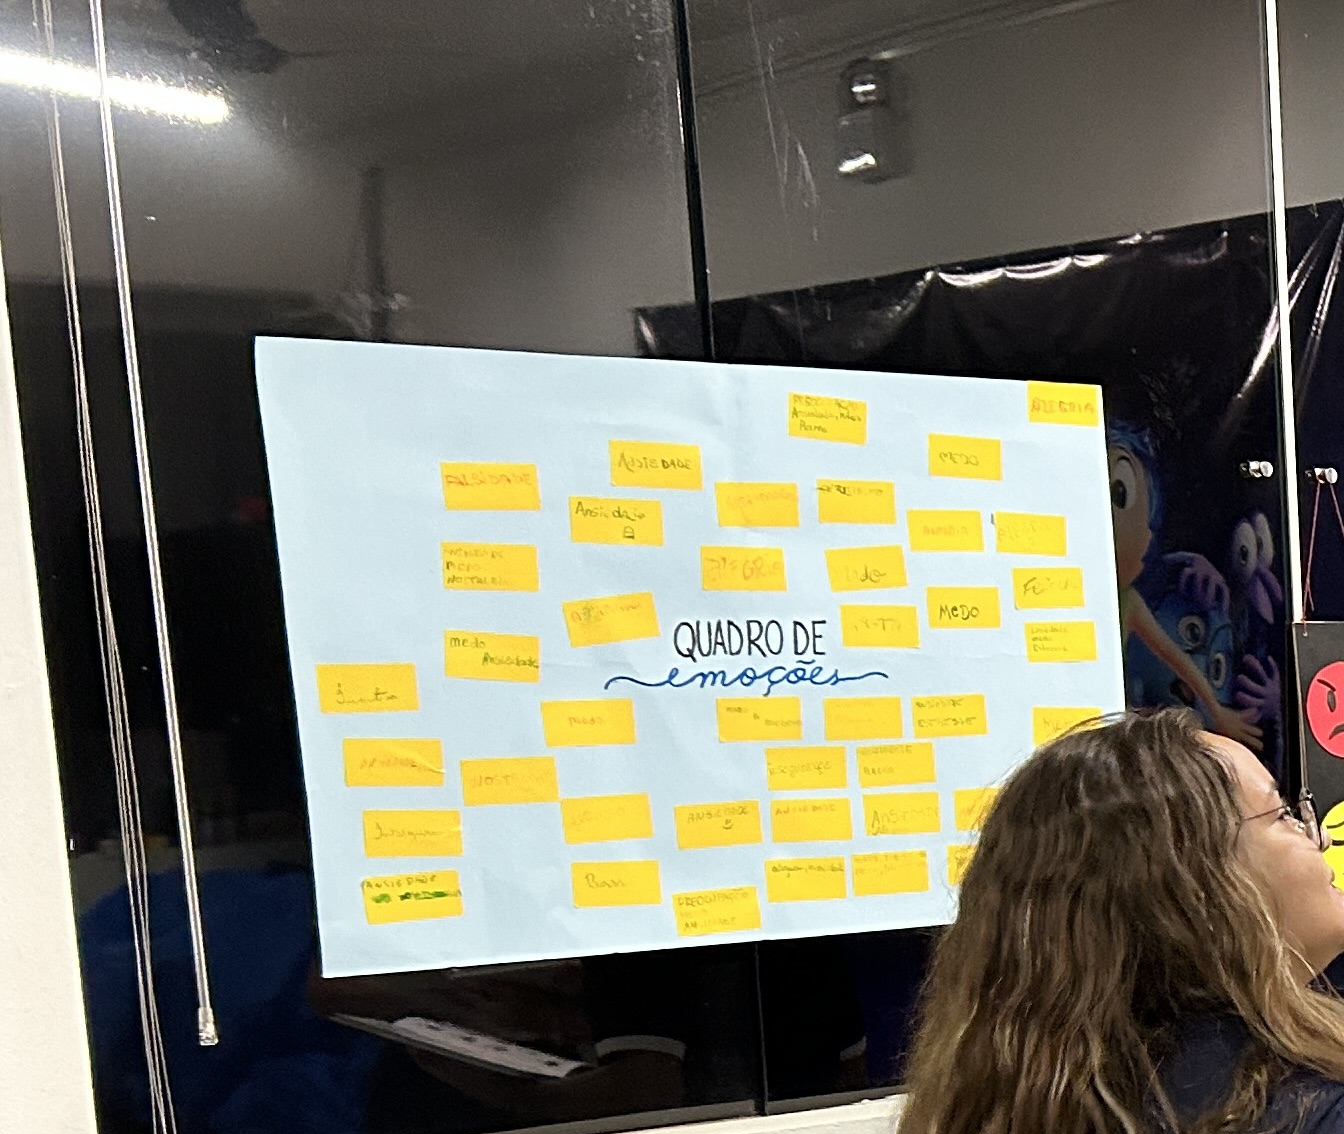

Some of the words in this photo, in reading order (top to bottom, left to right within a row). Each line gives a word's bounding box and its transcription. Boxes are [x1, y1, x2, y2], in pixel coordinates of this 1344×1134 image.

[673, 619, 784, 662] QUADRO
[792, 619, 827, 656] DE
[603, 658, 889, 697] emoções
